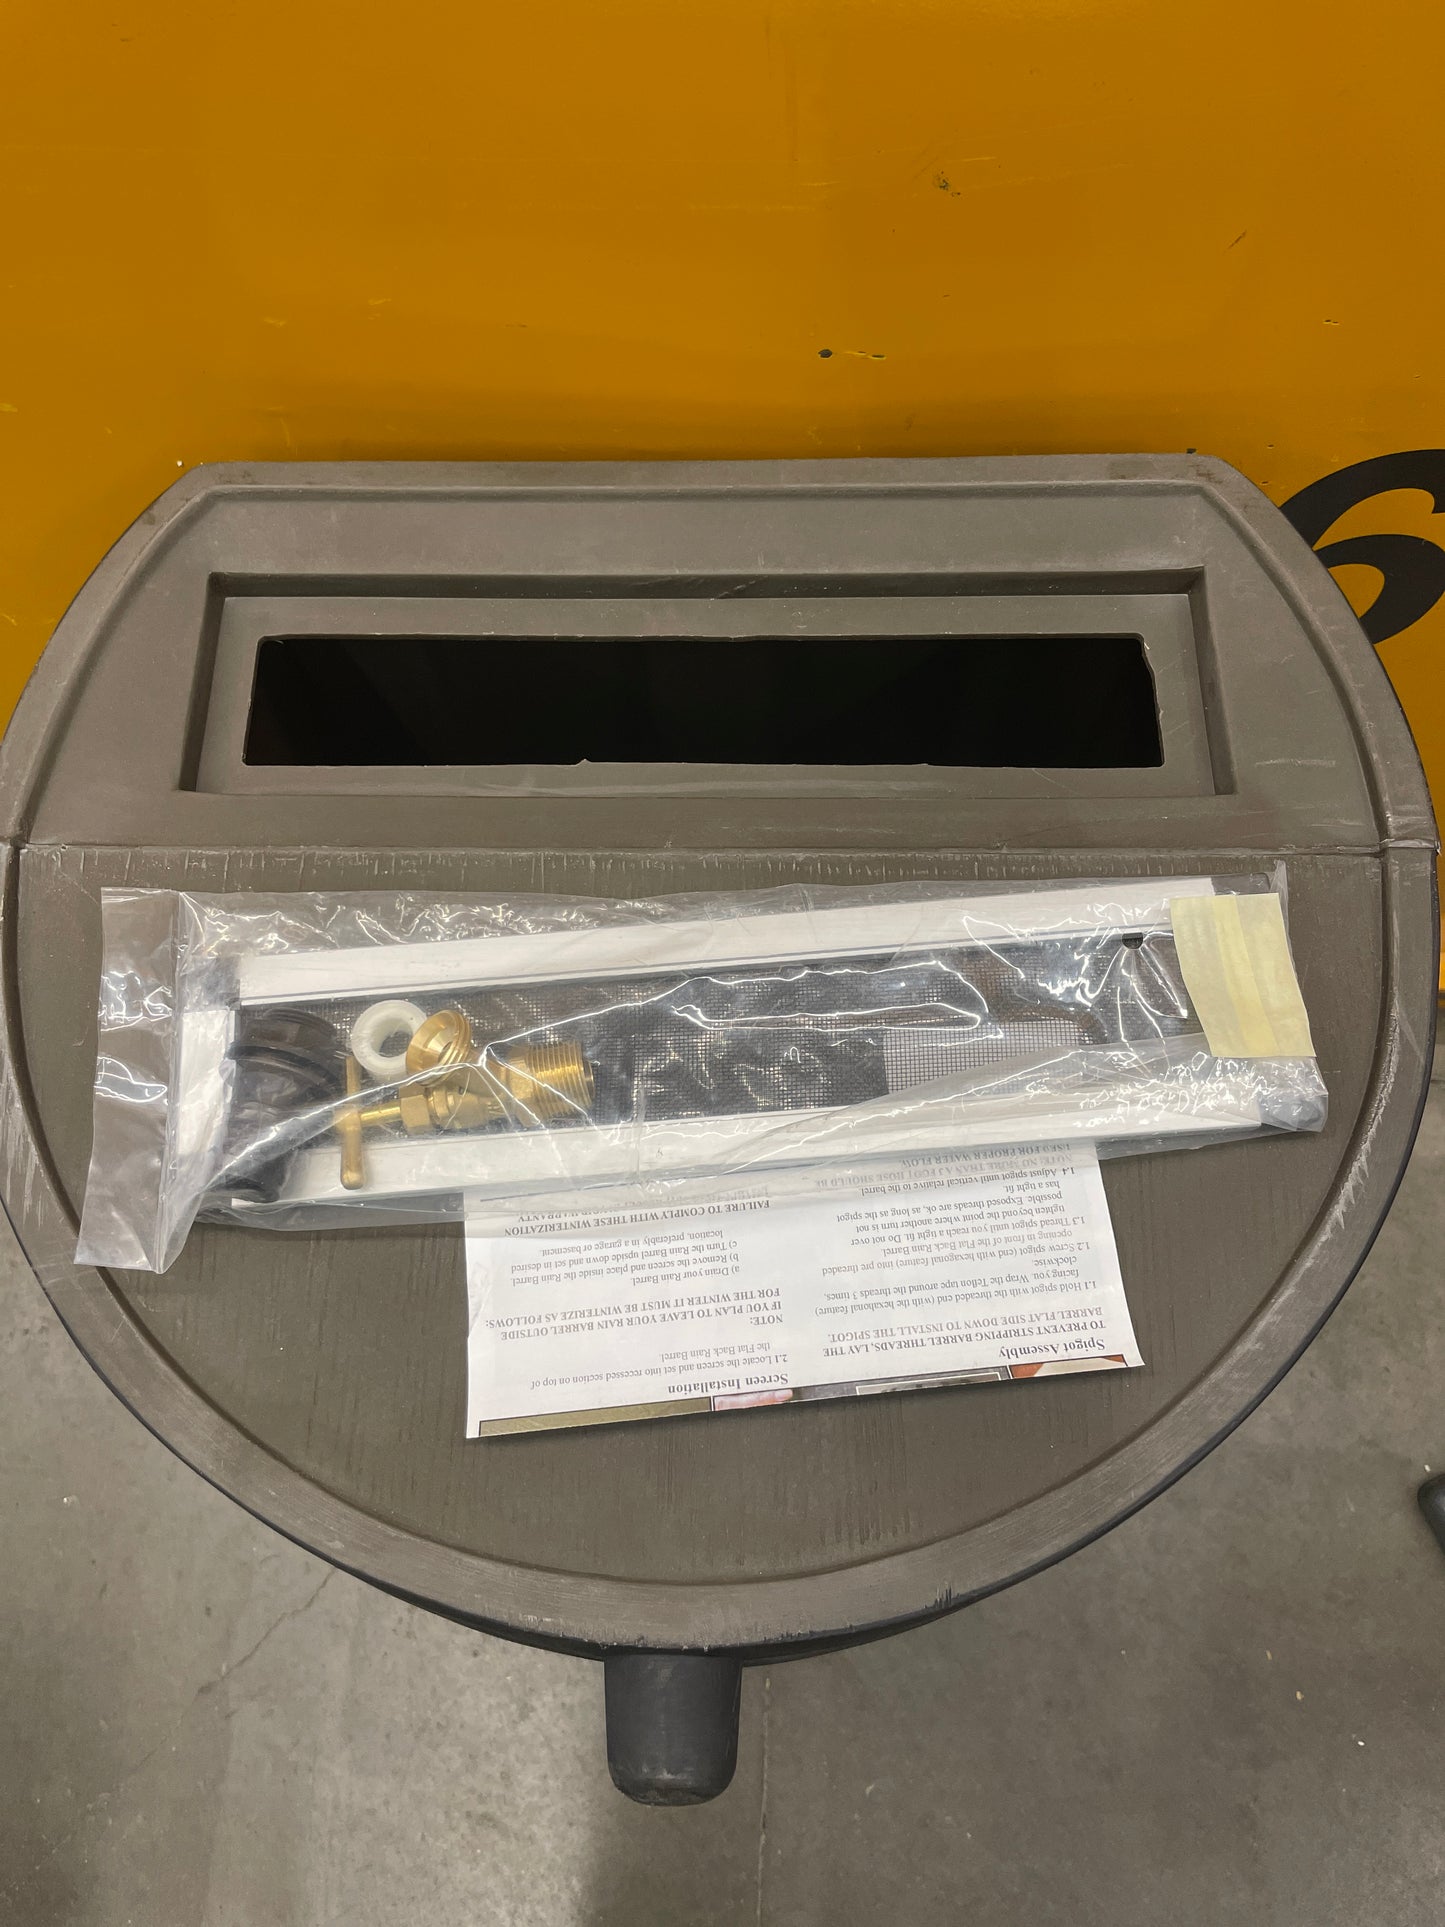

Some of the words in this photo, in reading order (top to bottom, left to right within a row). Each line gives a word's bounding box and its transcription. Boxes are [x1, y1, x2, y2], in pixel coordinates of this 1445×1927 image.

[1000, 1169, 1028, 1181] spigot
[1028, 1167, 1057, 1178] Adjust
[1061, 1166, 1074, 1175] 1.4
[946, 1176, 979, 1188] vertical
[979, 1173, 1001, 1184] until
[886, 1184, 902, 1194] the
[901, 1182, 913, 1193] to
[912, 1179, 945, 1192] relative
[723, 1199, 769, 1212] FAILURE
[937, 1203, 952, 1211] are
[953, 1200, 985, 1211] threads
[985, 1195, 1024, 1209] Exposed
[660, 1206, 705, 1219] COMPLY
[706, 1204, 723, 1214] TO
[878, 1209, 889, 1217] as
[889, 1207, 910, 1217] long
[911, 1206, 921, 1214] as
[592, 1215, 627, 1227] THESE
[629, 1211, 659, 1223] WITH
[836, 1210, 864, 1222] spigot
[863, 1211, 878, 1221] the
[1071, 1215, 1085, 1225] 1.3
[504, 1219, 591, 1236] WINTERIZATION
[969, 1222, 989, 1233] you
[988, 1222, 1009, 1234] until
[1010, 1217, 1038, 1230] spigot
[1038, 1216, 1071, 1229] Thread
[915, 1228, 937, 1240] tight
[937, 1229, 944, 1237] a
[944, 1226, 970, 1238] reach
[850, 1237, 870, 1245] over
[870, 1235, 886, 1244] not
[887, 1234, 901, 1243] Do
[690, 1244, 704, 1254] the
[705, 1242, 727, 1251] Turn
[727, 1239, 737, 1250] c)
[1018, 1243, 1046, 1256] spigot
[1046, 1242, 1075, 1254] Screw
[1075, 1241, 1090, 1251] 1.2
[610, 1250, 639, 1263] upside
[640, 1248, 667, 1260] Barrel
[668, 1246, 689, 1256] Rain
[728, 1251, 739, 1262] b)
[975, 1250, 996, 1261] with
[996, 1245, 1017, 1259] (end
[553, 1259, 566, 1268] set
[567, 1258, 584, 1268] and
[584, 1255, 610, 1264] down
[676, 1259, 690, 1267] the
[691, 1254, 727, 1264] Remove
[894, 1256, 929, 1269] feature)
[930, 1251, 975, 1265] hexagonal
[510, 1262, 541, 1274] desired
[542, 1261, 552, 1270] in
[605, 1263, 628, 1275] place
[629, 1264, 646, 1274] and
[646, 1260, 675, 1269] screen
[730, 1264, 739, 1274] a)
[821, 1264, 858, 1276] threaded
[859, 1260, 874, 1271] pre
[876, 1260, 894, 1270] into
[562, 1271, 576, 1280] the
[578, 1268, 603, 1279] inside
[659, 1272, 681, 1282] Rain
[682, 1267, 703, 1278] your
[703, 1267, 729, 1277] Drain
[1050, 1267, 1079, 1279] facing
[540, 1273, 561, 1283] Rain
[959, 1277, 989, 1289] Teflon
[989, 1275, 1004, 1286] the
[1004, 1273, 1030, 1284] Wrap
[892, 1285, 907, 1295] the
[907, 1282, 939, 1294] around
[939, 1279, 960, 1291] tape
[1028, 1281, 1058, 1294] spigot
[1058, 1281, 1081, 1293] Hold
[1083, 1280, 1096, 1289] 1.1
[732, 1290, 756, 1301] THE
[756, 1287, 780, 1298] FOR
[851, 1290, 858, 1300] 3
[859, 1287, 892, 1299] threads
[953, 1290, 992, 1303] threaded
[993, 1288, 1008, 1298] the
[1008, 1286, 1029, 1297] with
[672, 1297, 684, 1307] IT
[686, 1293, 731, 1305] WINTER
[895, 1298, 910, 1308] the
[910, 1293, 935, 1307] (with
[935, 1294, 953, 1304] end
[623, 1303, 638, 1313] BE
[640, 1299, 671, 1311] MUST
[714, 1304, 743, 1316] PLAN
[745, 1301, 769, 1313] YOU
[770, 1300, 781, 1310] IF
[814, 1304, 848, 1316] feature)
[544, 1312, 558, 1322] AS
[560, 1305, 622, 1320] WINTERIZE
[658, 1309, 694, 1322] LEAVE
[696, 1307, 712, 1318] TO
[1027, 1311, 1056, 1323] FLAT
[1056, 1306, 1102, 1319] BARREL
[485, 1314, 542, 1328] FOLLOWS:
[596, 1317, 623, 1329] RAIN
[625, 1313, 657, 1326] YOUR
[749, 1313, 782, 1325] NOTE:
[963, 1317, 999, 1329] DOWN
[999, 1314, 1026, 1325] SIDE
[1089, 1319, 1105, 1329] TO
[549, 1321, 594, 1334] BARREL
[896, 1322, 943, 1335] INSTALL
[945, 1320, 962, 1331] TO
[1035, 1321, 1088, 1335] PREVENT
[500, 1326, 548, 1340] OUTSIDE
[872, 1327, 896, 1338] THE
[974, 1326, 1033, 1341] STRIPPING
[926, 1332, 972, 1345] BARREL
[1062, 1336, 1105, 1352] Spigot
[712, 1345, 736, 1357] Back
[736, 1343, 755, 1354] Flat
[755, 1341, 770, 1353] the
[822, 1345, 846, 1356] THE
[847, 1343, 869, 1354] LAY
[999, 1343, 1059, 1359] Assembly
[689, 1348, 711, 1359] Rain
[774, 1353, 787, 1363] 2.1
[695, 1360, 724, 1370] screen
[725, 1358, 740, 1368] the
[741, 1355, 772, 1365] Locate
[643, 1367, 661, 1376] into
[662, 1365, 676, 1374] set
[677, 1363, 694, 1374] and
[571, 1373, 603, 1384] section
[605, 1369, 642, 1381] recessed
[744, 1373, 788, 1385] Screen
[529, 1380, 540, 1390] of
[541, 1376, 557, 1386] top
[667, 1378, 740, 1394] Installation
